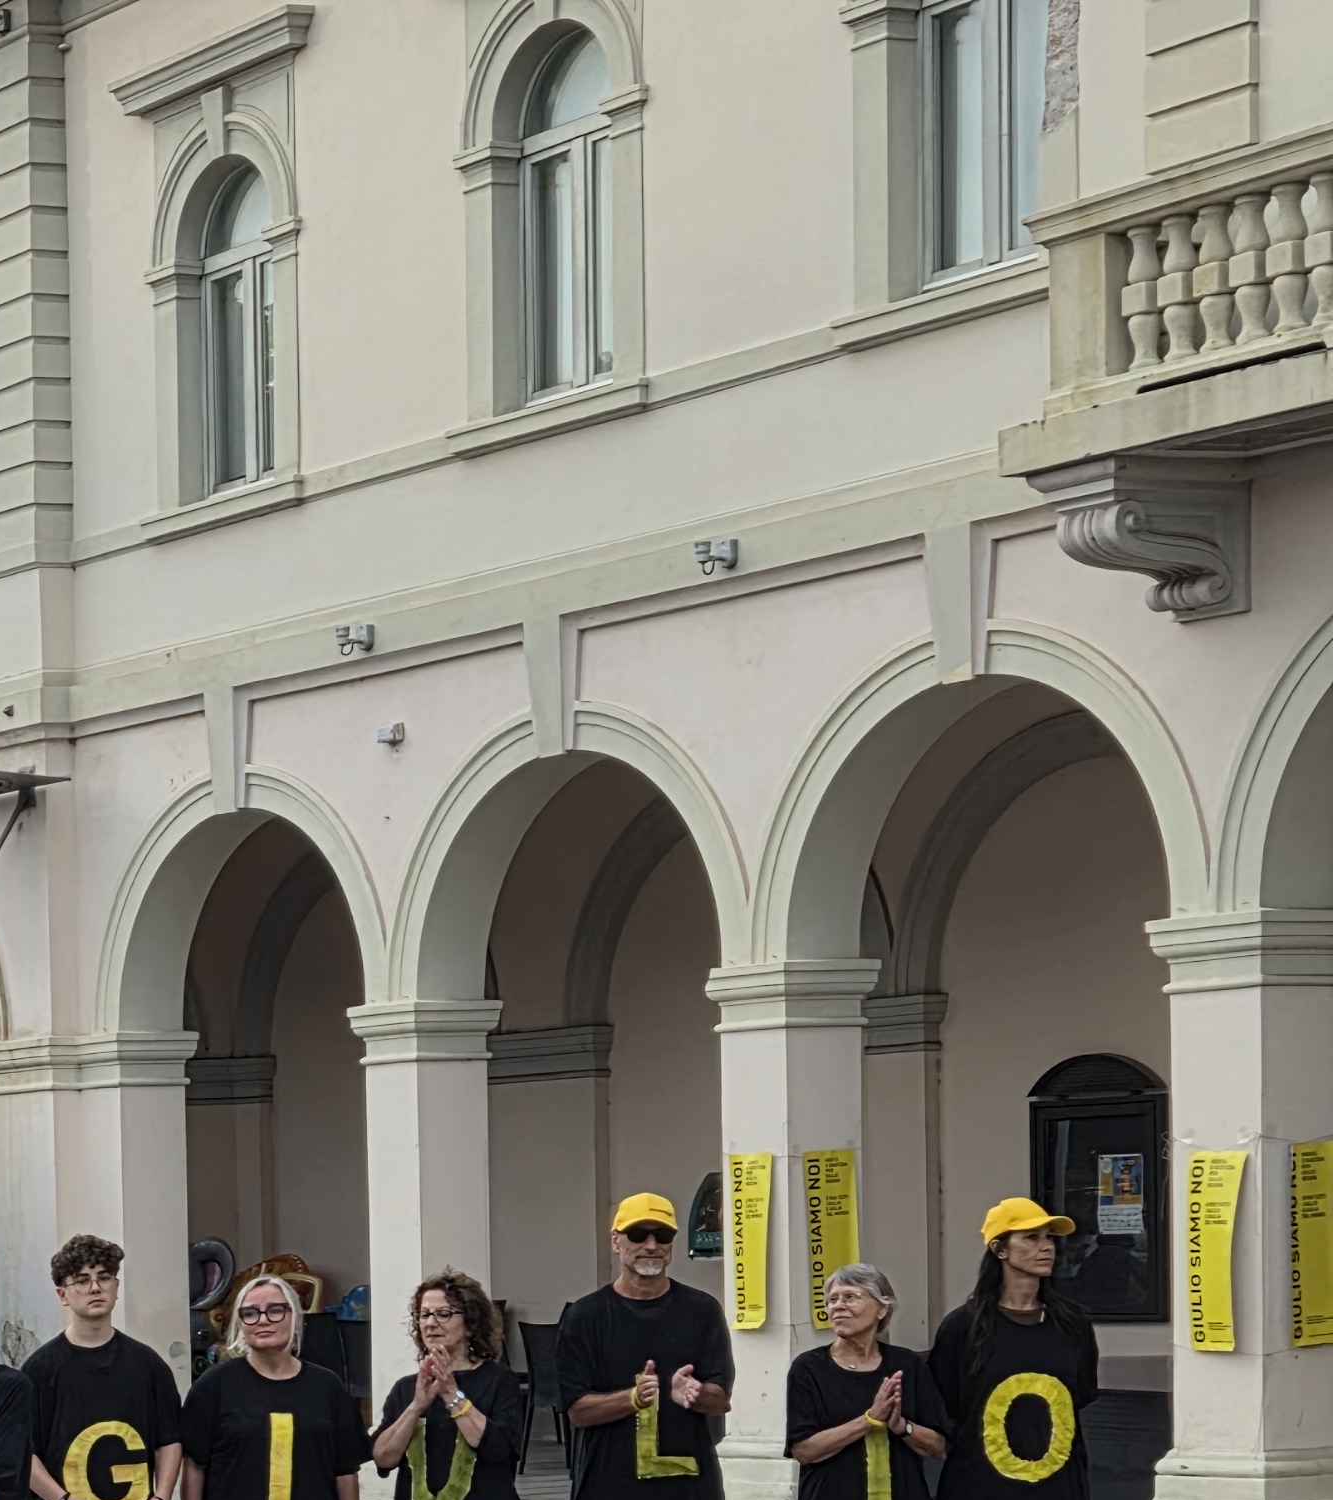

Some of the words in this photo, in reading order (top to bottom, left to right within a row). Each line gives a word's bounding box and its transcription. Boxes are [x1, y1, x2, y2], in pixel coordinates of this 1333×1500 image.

[732, 1160, 744, 1193] NOI
[807, 1157, 821, 1191] NOI
[1191, 1159, 1206, 1194] NOI
[734, 1198, 744, 1257] SIAMO
[808, 1195, 824, 1256] SIAMO
[1189, 1201, 1202, 1267] SIAMO
[735, 1262, 746, 1323] GIULIO
[812, 1260, 830, 1322] GIULIO
[1190, 1274, 1206, 1343] GIULIO
[1291, 1269, 1304, 1340] GIULIO
[635, 1373, 699, 1480] L
[982, 1371, 1076, 1483] O
